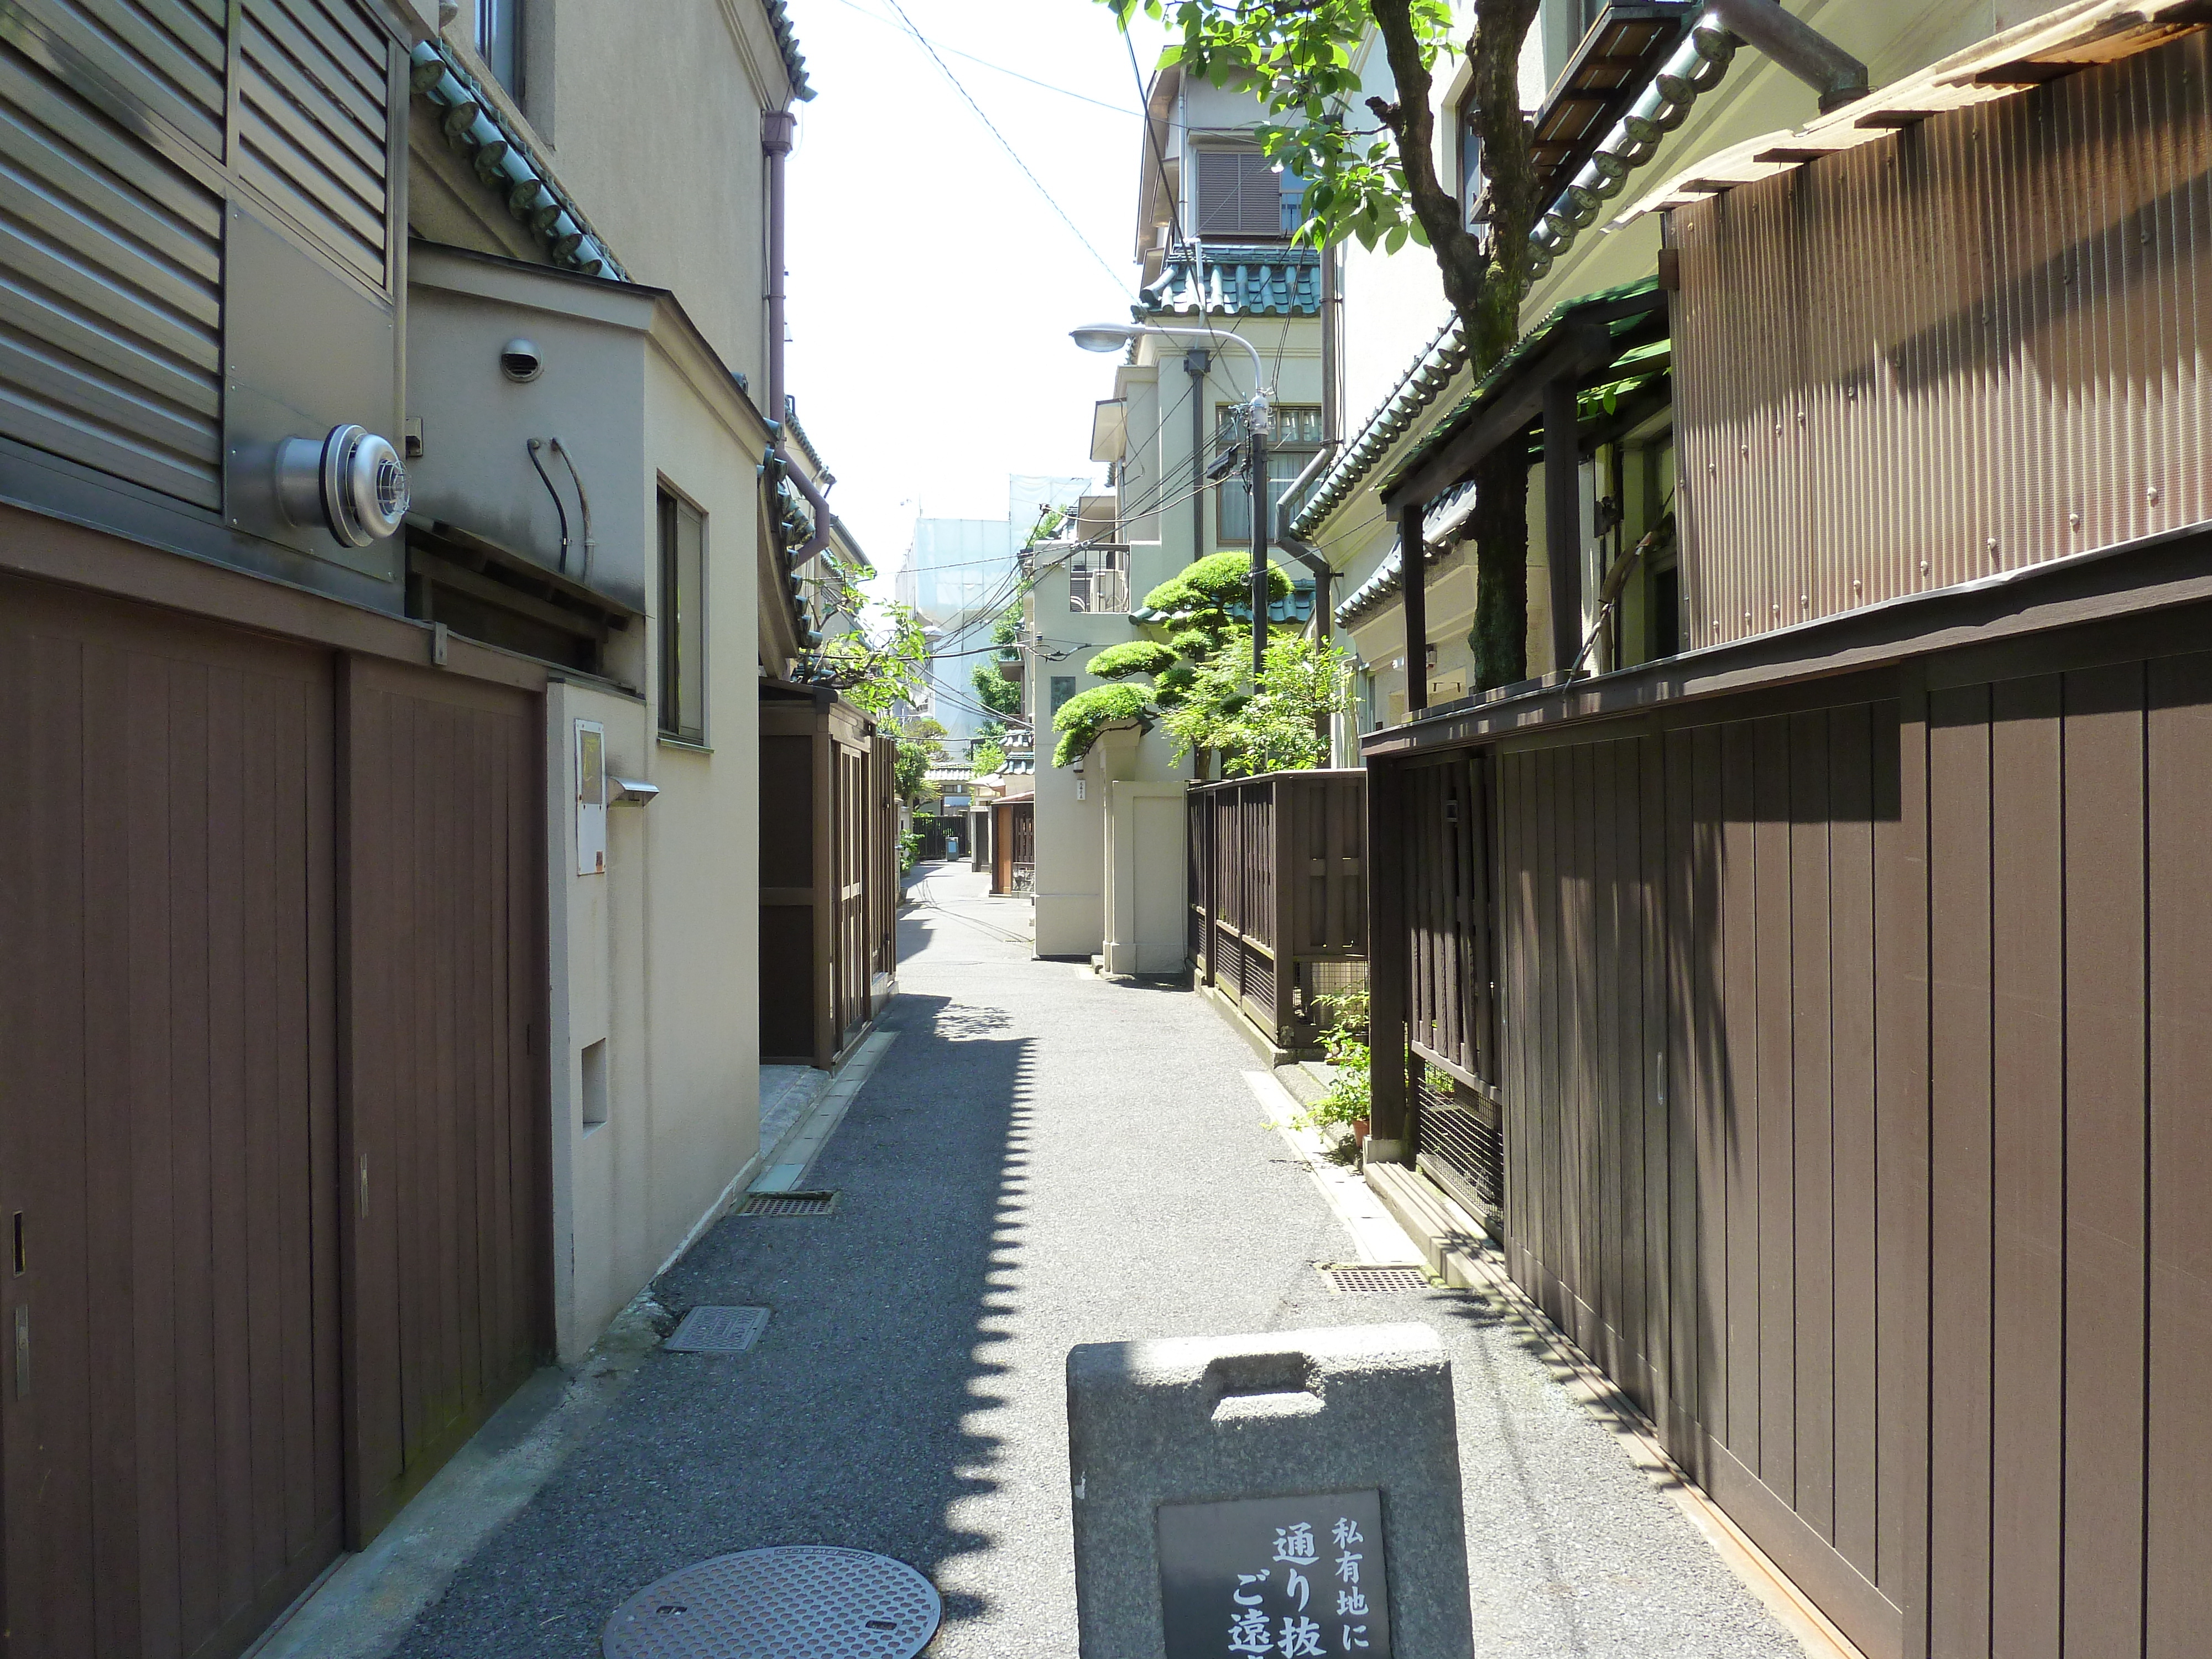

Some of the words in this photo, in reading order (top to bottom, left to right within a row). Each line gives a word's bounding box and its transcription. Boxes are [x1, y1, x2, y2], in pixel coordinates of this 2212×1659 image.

[1228, 1569, 1274, 1659] ご遠
[1272, 1522, 1327, 1659] 通り抜
[1332, 1517, 1369, 1651] 私有地に
